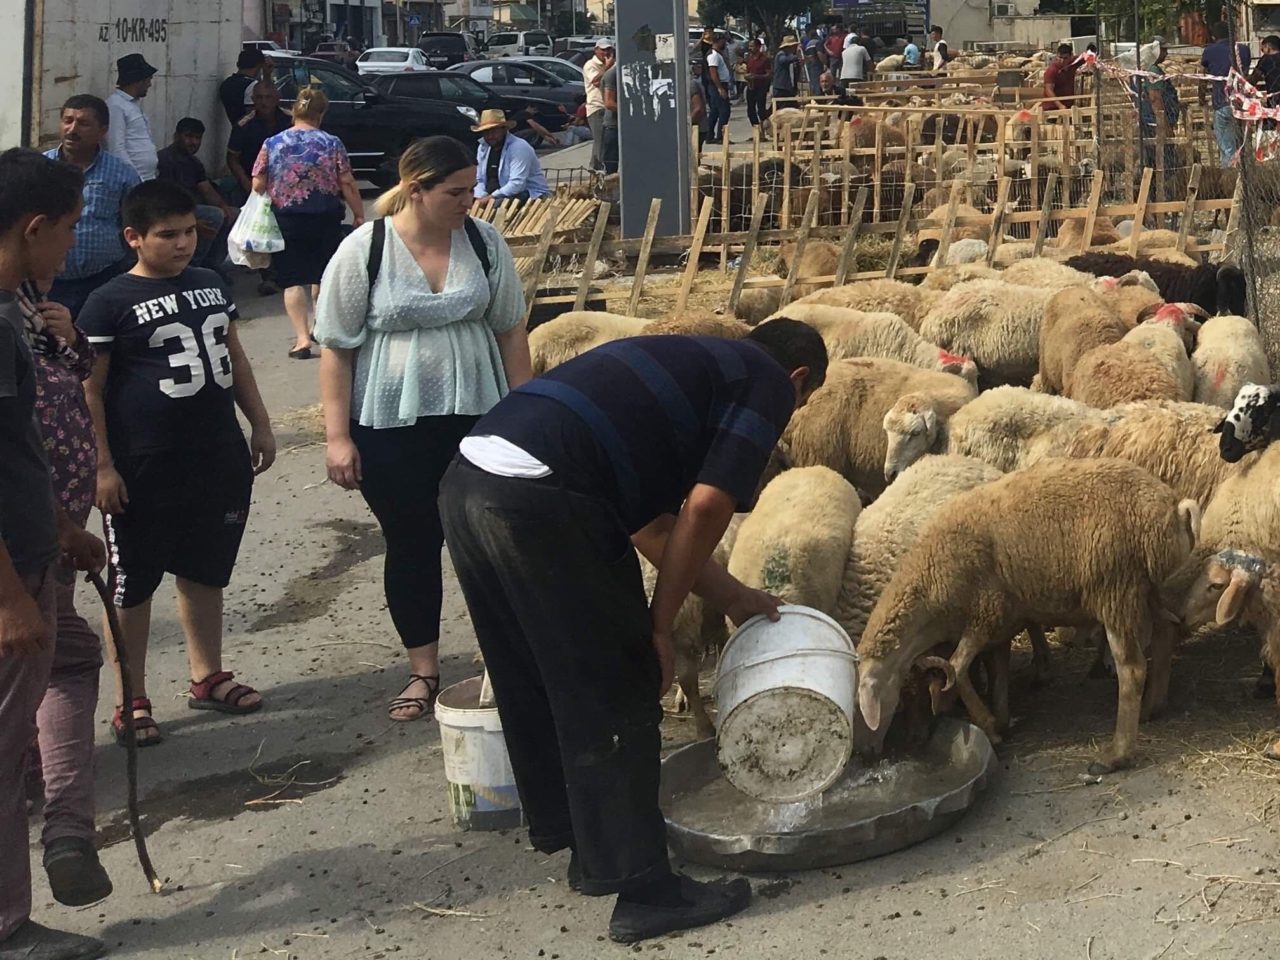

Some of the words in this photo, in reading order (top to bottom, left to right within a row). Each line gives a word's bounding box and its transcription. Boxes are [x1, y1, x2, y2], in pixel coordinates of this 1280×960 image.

[98, 26, 109, 42] AZ
[116, 17, 167, 43] 10-KR-495
[132, 294, 179, 325] NEW
[182, 287, 227, 310] YORK
[148, 311, 233, 399] 36
